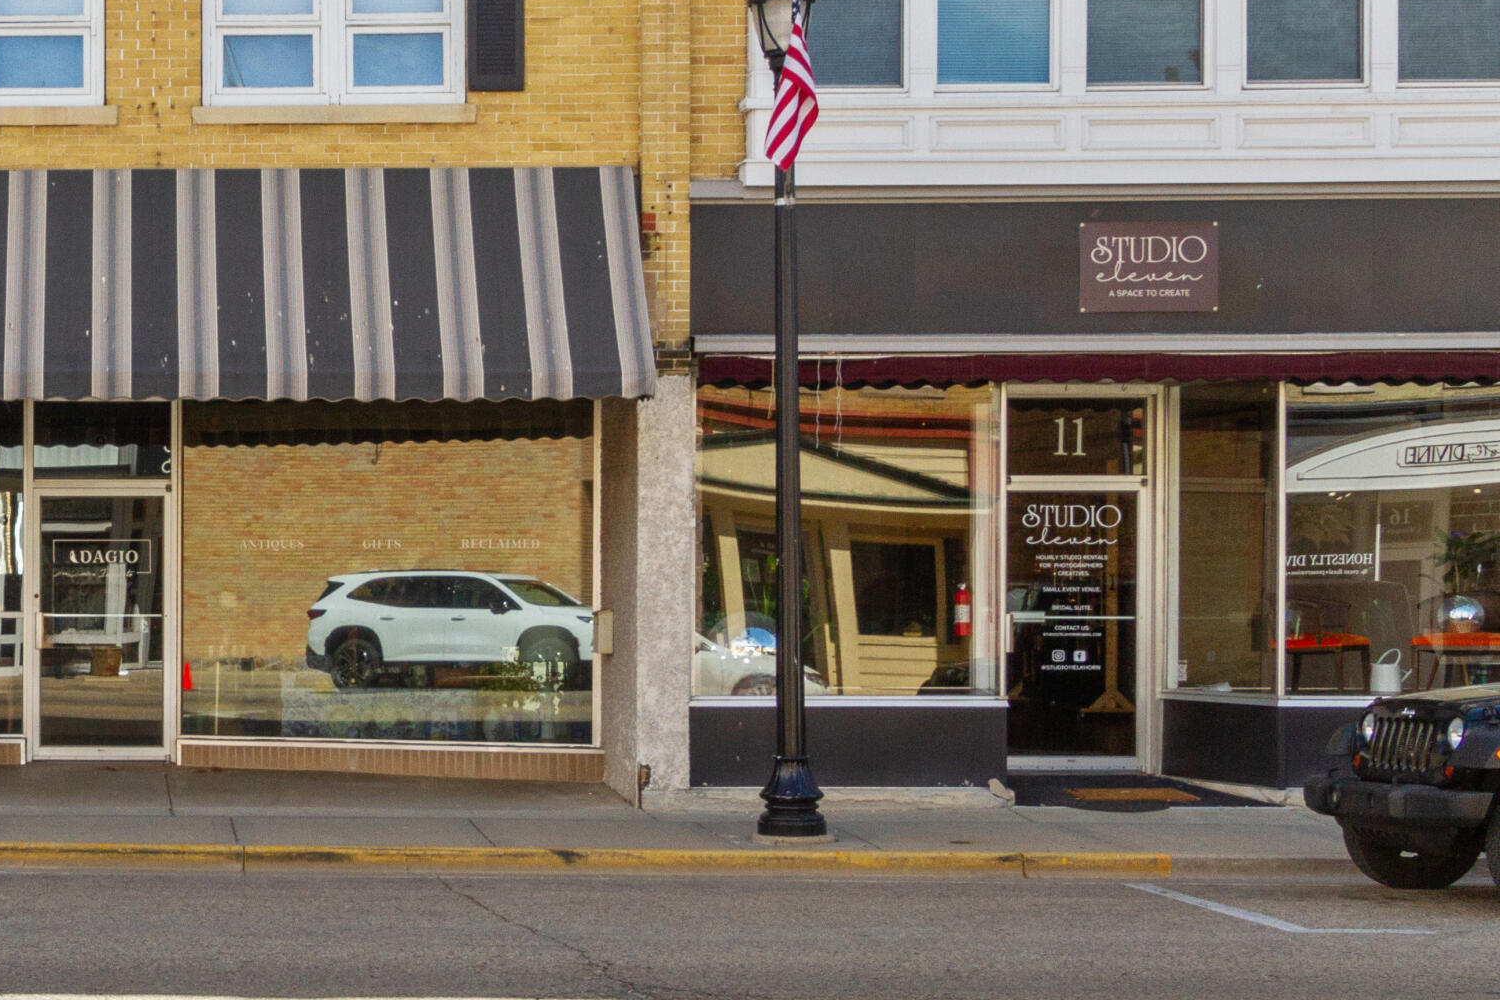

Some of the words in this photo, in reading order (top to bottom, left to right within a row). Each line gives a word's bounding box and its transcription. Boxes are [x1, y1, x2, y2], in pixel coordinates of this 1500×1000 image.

[1090, 235, 1208, 264] STUDIO
[1095, 261, 1204, 282] eleven
[1108, 289, 1115, 297] A
[1116, 288, 1144, 297] SPACE
[1146, 288, 1157, 297] TO
[1159, 288, 1190, 297] CREATE
[1053, 416, 1087, 456] 11
[1021, 504, 1122, 528] STUDIO
[239, 538, 305, 551] ANTIQUES
[362, 538, 401, 550] GIFTS
[461, 538, 540, 550] RECLAIMED
[1026, 527, 1118, 545] eleven
